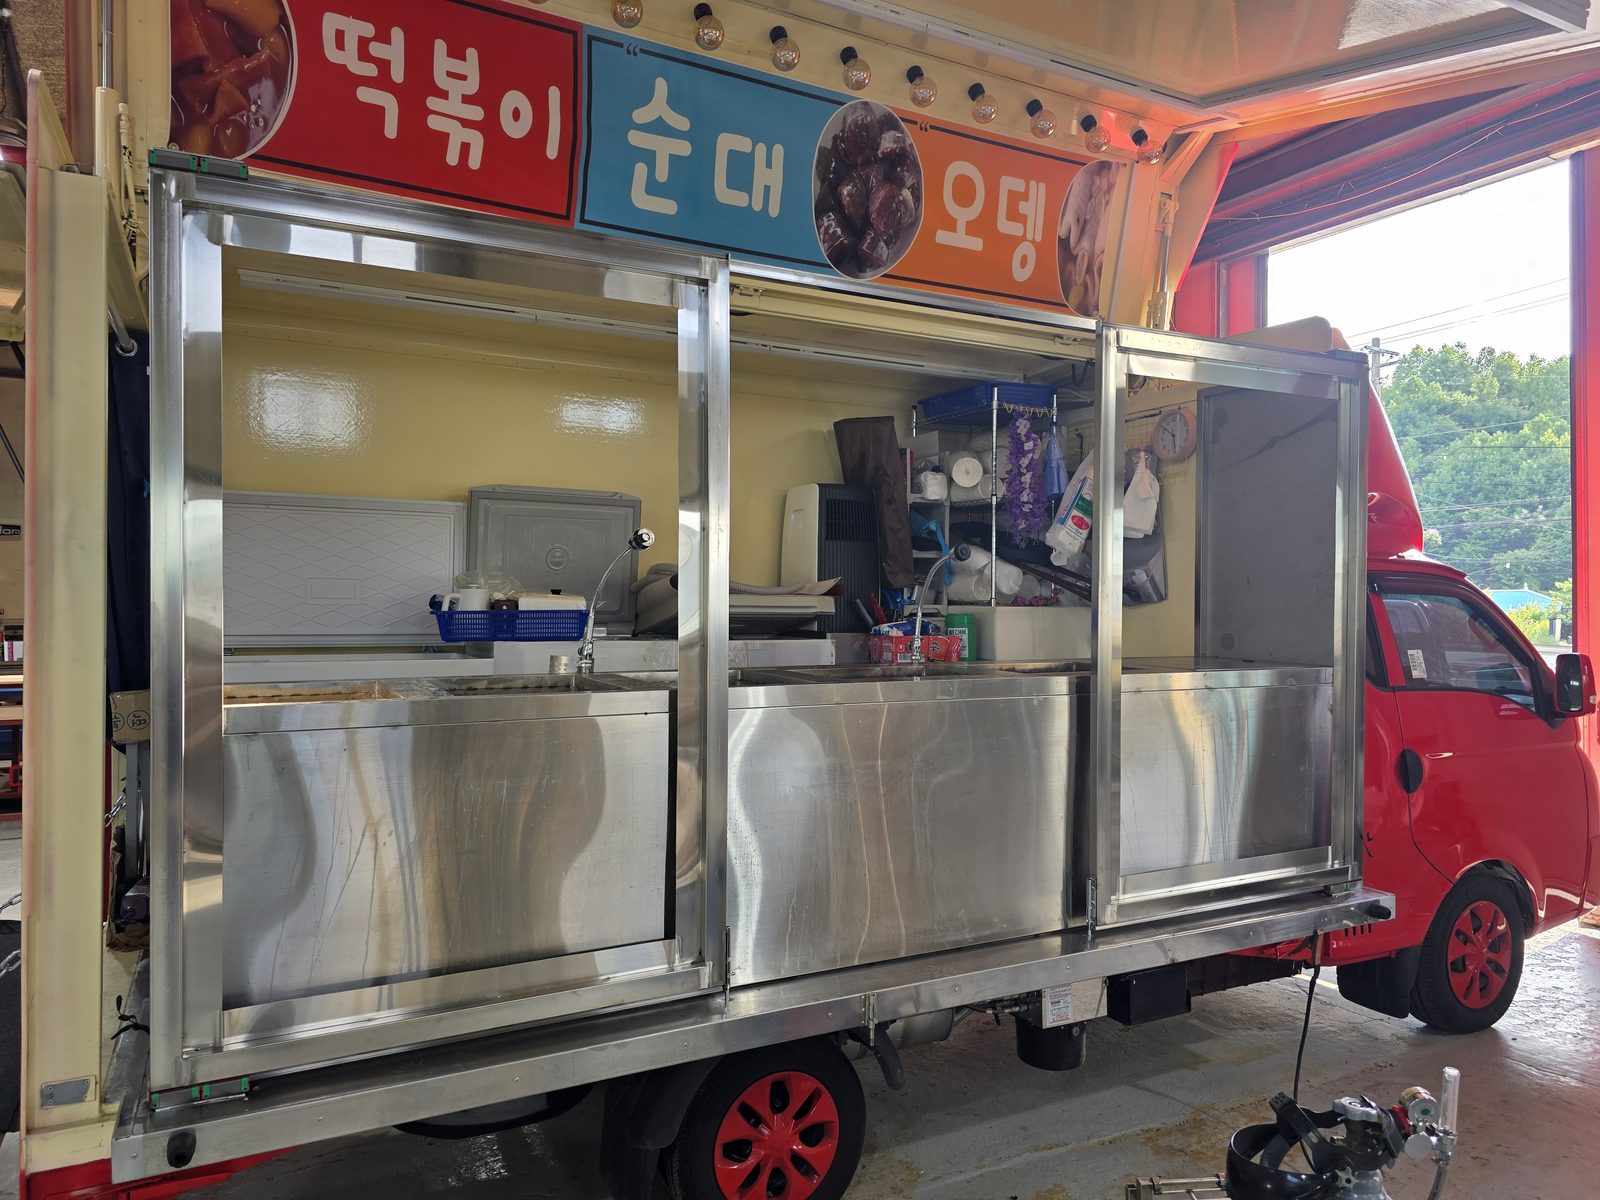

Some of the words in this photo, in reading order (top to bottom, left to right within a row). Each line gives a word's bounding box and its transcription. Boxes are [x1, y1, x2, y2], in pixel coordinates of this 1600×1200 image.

[322, 11, 561, 171] 떡볶이
[626, 76, 785, 218] 순대
[935, 159, 1046, 283] 오뎅
